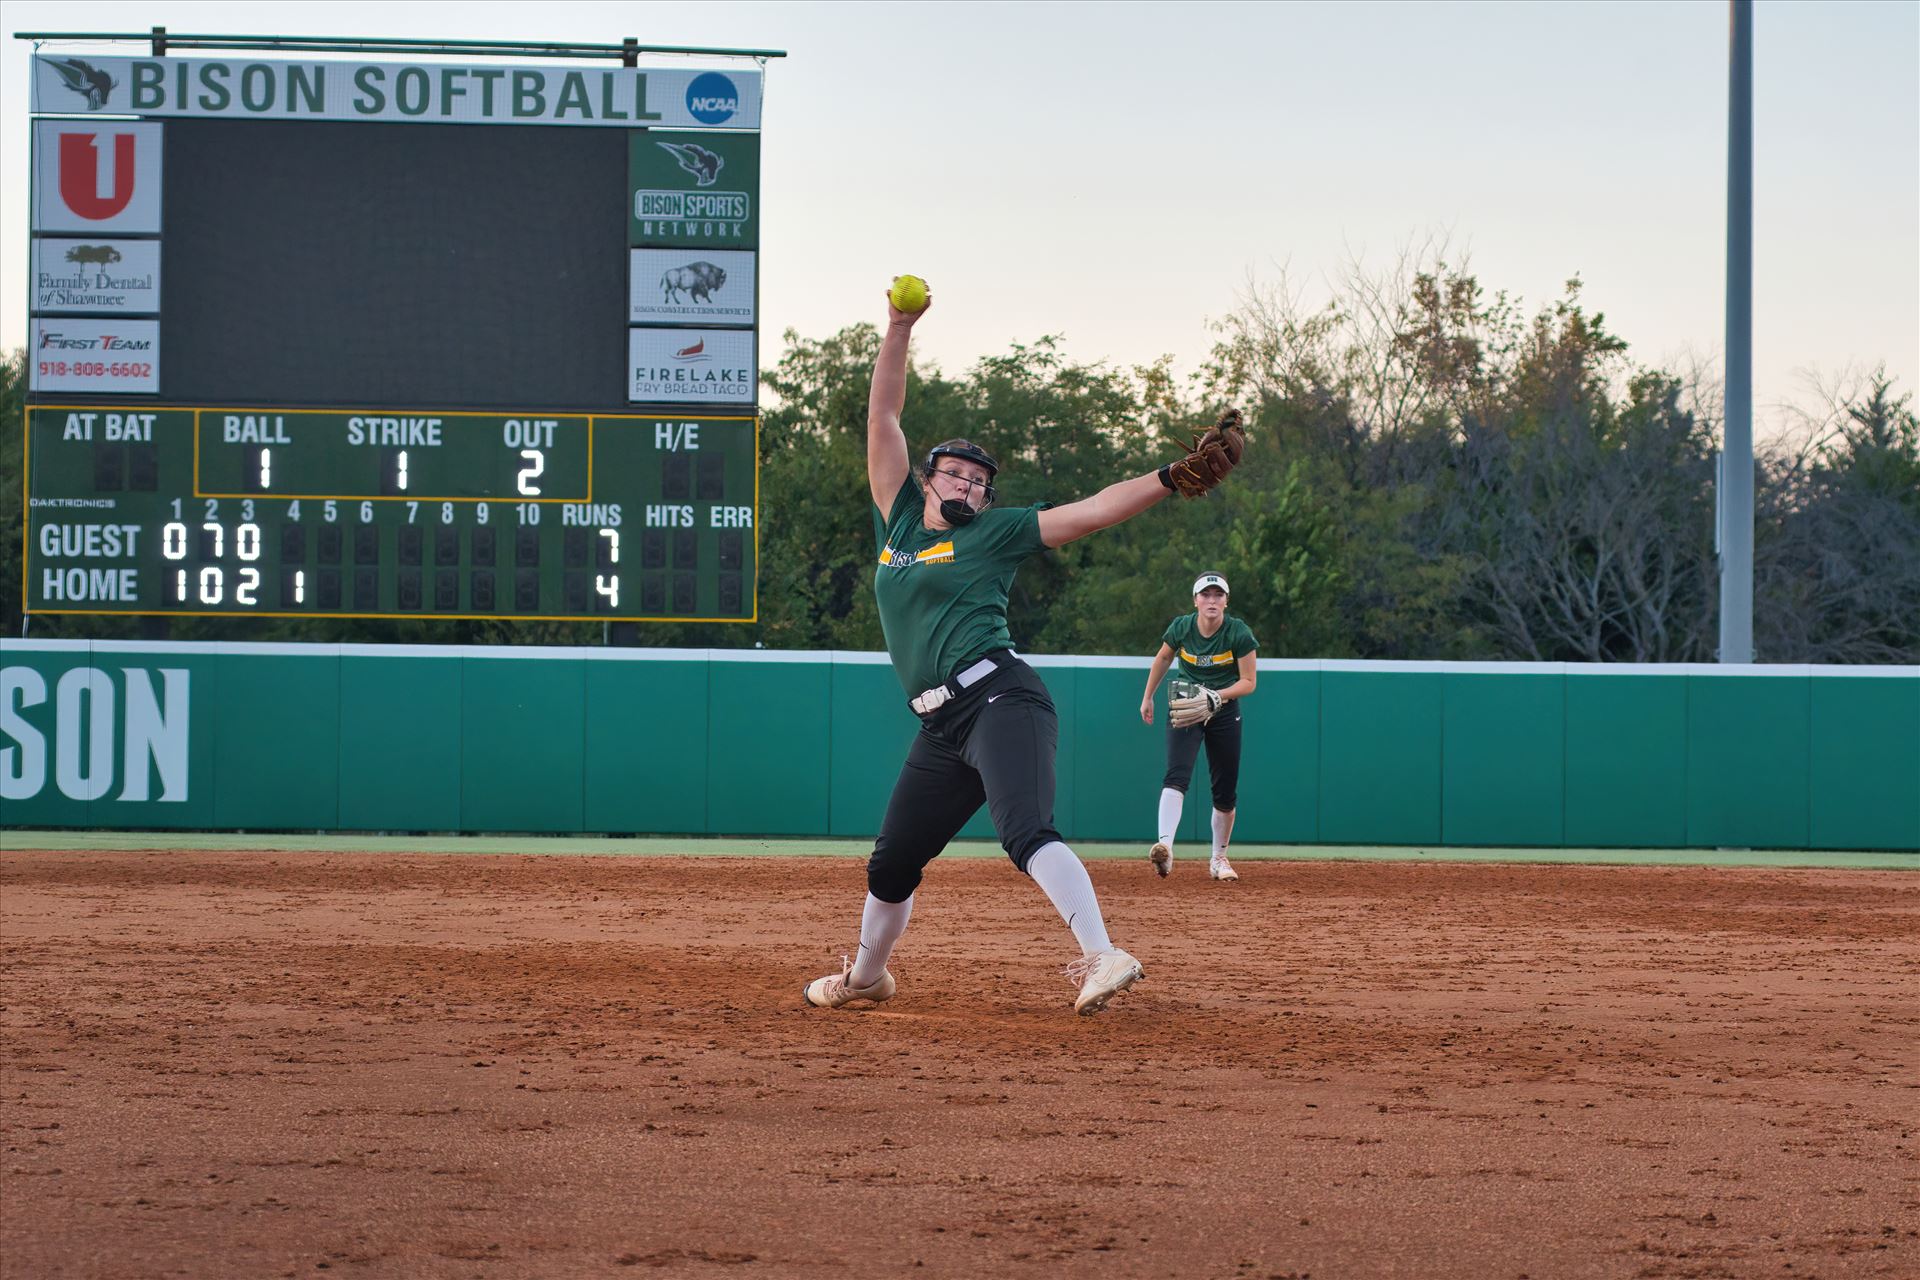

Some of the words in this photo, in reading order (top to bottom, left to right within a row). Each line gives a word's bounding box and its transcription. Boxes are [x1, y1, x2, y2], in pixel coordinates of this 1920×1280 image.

[130, 61, 325, 113] BISON
[353, 66, 661, 121] SOFTBALL
[691, 97, 737, 112] NCAA
[641, 193, 682, 215] BISON
[686, 196, 744, 217] SPORTS
[643, 221, 741, 237] NETWORK
[39, 273, 90, 291] Family
[95, 274, 152, 289] Dental
[40, 290, 55, 306] of
[56, 290, 125, 305] Shawnee
[636, 368, 748, 382] FIRELAKE
[636, 383, 660, 393] FRY
[664, 384, 708, 394] BREAD
[712, 385, 748, 395] TACO
[63, 414, 97, 441] AT
[105, 414, 156, 442] BAT
[223, 416, 291, 443] BALL
[348, 418, 442, 446] STRIKE
[503, 421, 558, 448] OUT
[655, 423, 699, 452] H/E
[261, 448, 270, 489] 1
[398, 450, 407, 490] 1
[517, 449, 544, 495] 2
[171, 499, 182, 520] 1
[206, 499, 219, 520] 2
[242, 500, 254, 521] 3
[287, 501, 300, 522] 4
[324, 501, 337, 522] 5
[361, 501, 374, 523] 6
[406, 502, 418, 524] 7
[441, 503, 454, 524] 8
[477, 503, 490, 525] 9
[516, 503, 541, 526] 10
[562, 504, 622, 526] RUNS
[646, 506, 694, 528] HITS
[710, 507, 752, 528] ERR
[40, 524, 141, 557] GUEST
[600, 529, 619, 563] 7
[43, 569, 138, 601] HOME
[295, 570, 304, 603] 1
[596, 575, 619, 608] 4
